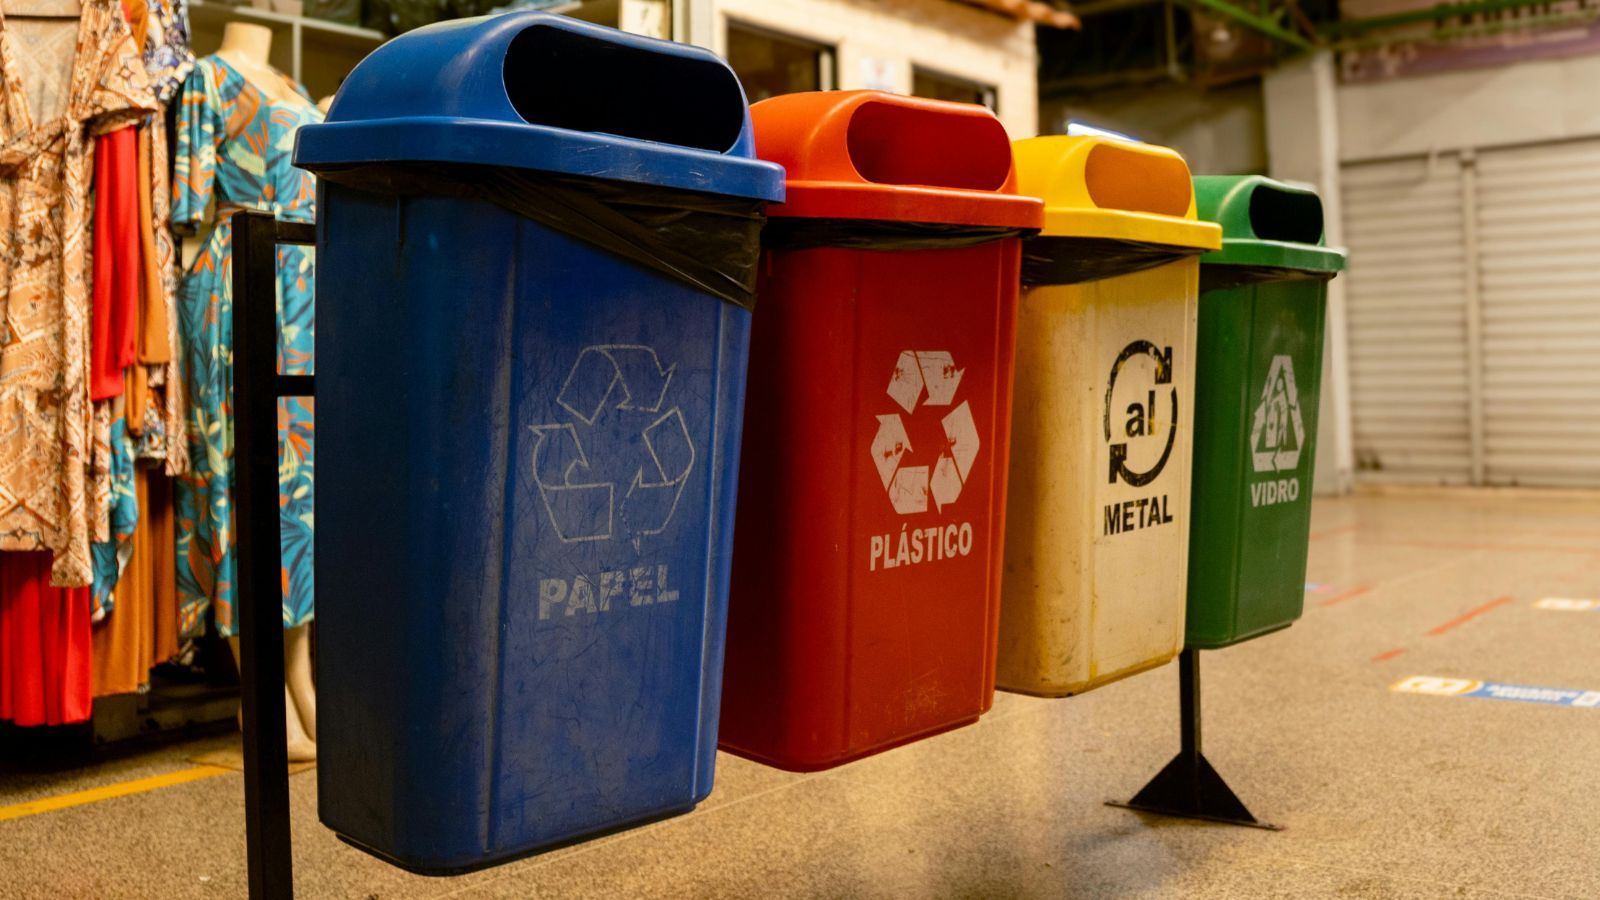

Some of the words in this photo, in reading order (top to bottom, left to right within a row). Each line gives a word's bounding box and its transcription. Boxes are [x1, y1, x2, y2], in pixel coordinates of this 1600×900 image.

[1126, 390, 1156, 438] al
[1104, 495, 1173, 536] METAL
[1250, 478, 1299, 507] VIDRO
[869, 521, 973, 571] PLÁSTICO
[538, 565, 679, 620] PAPEL
